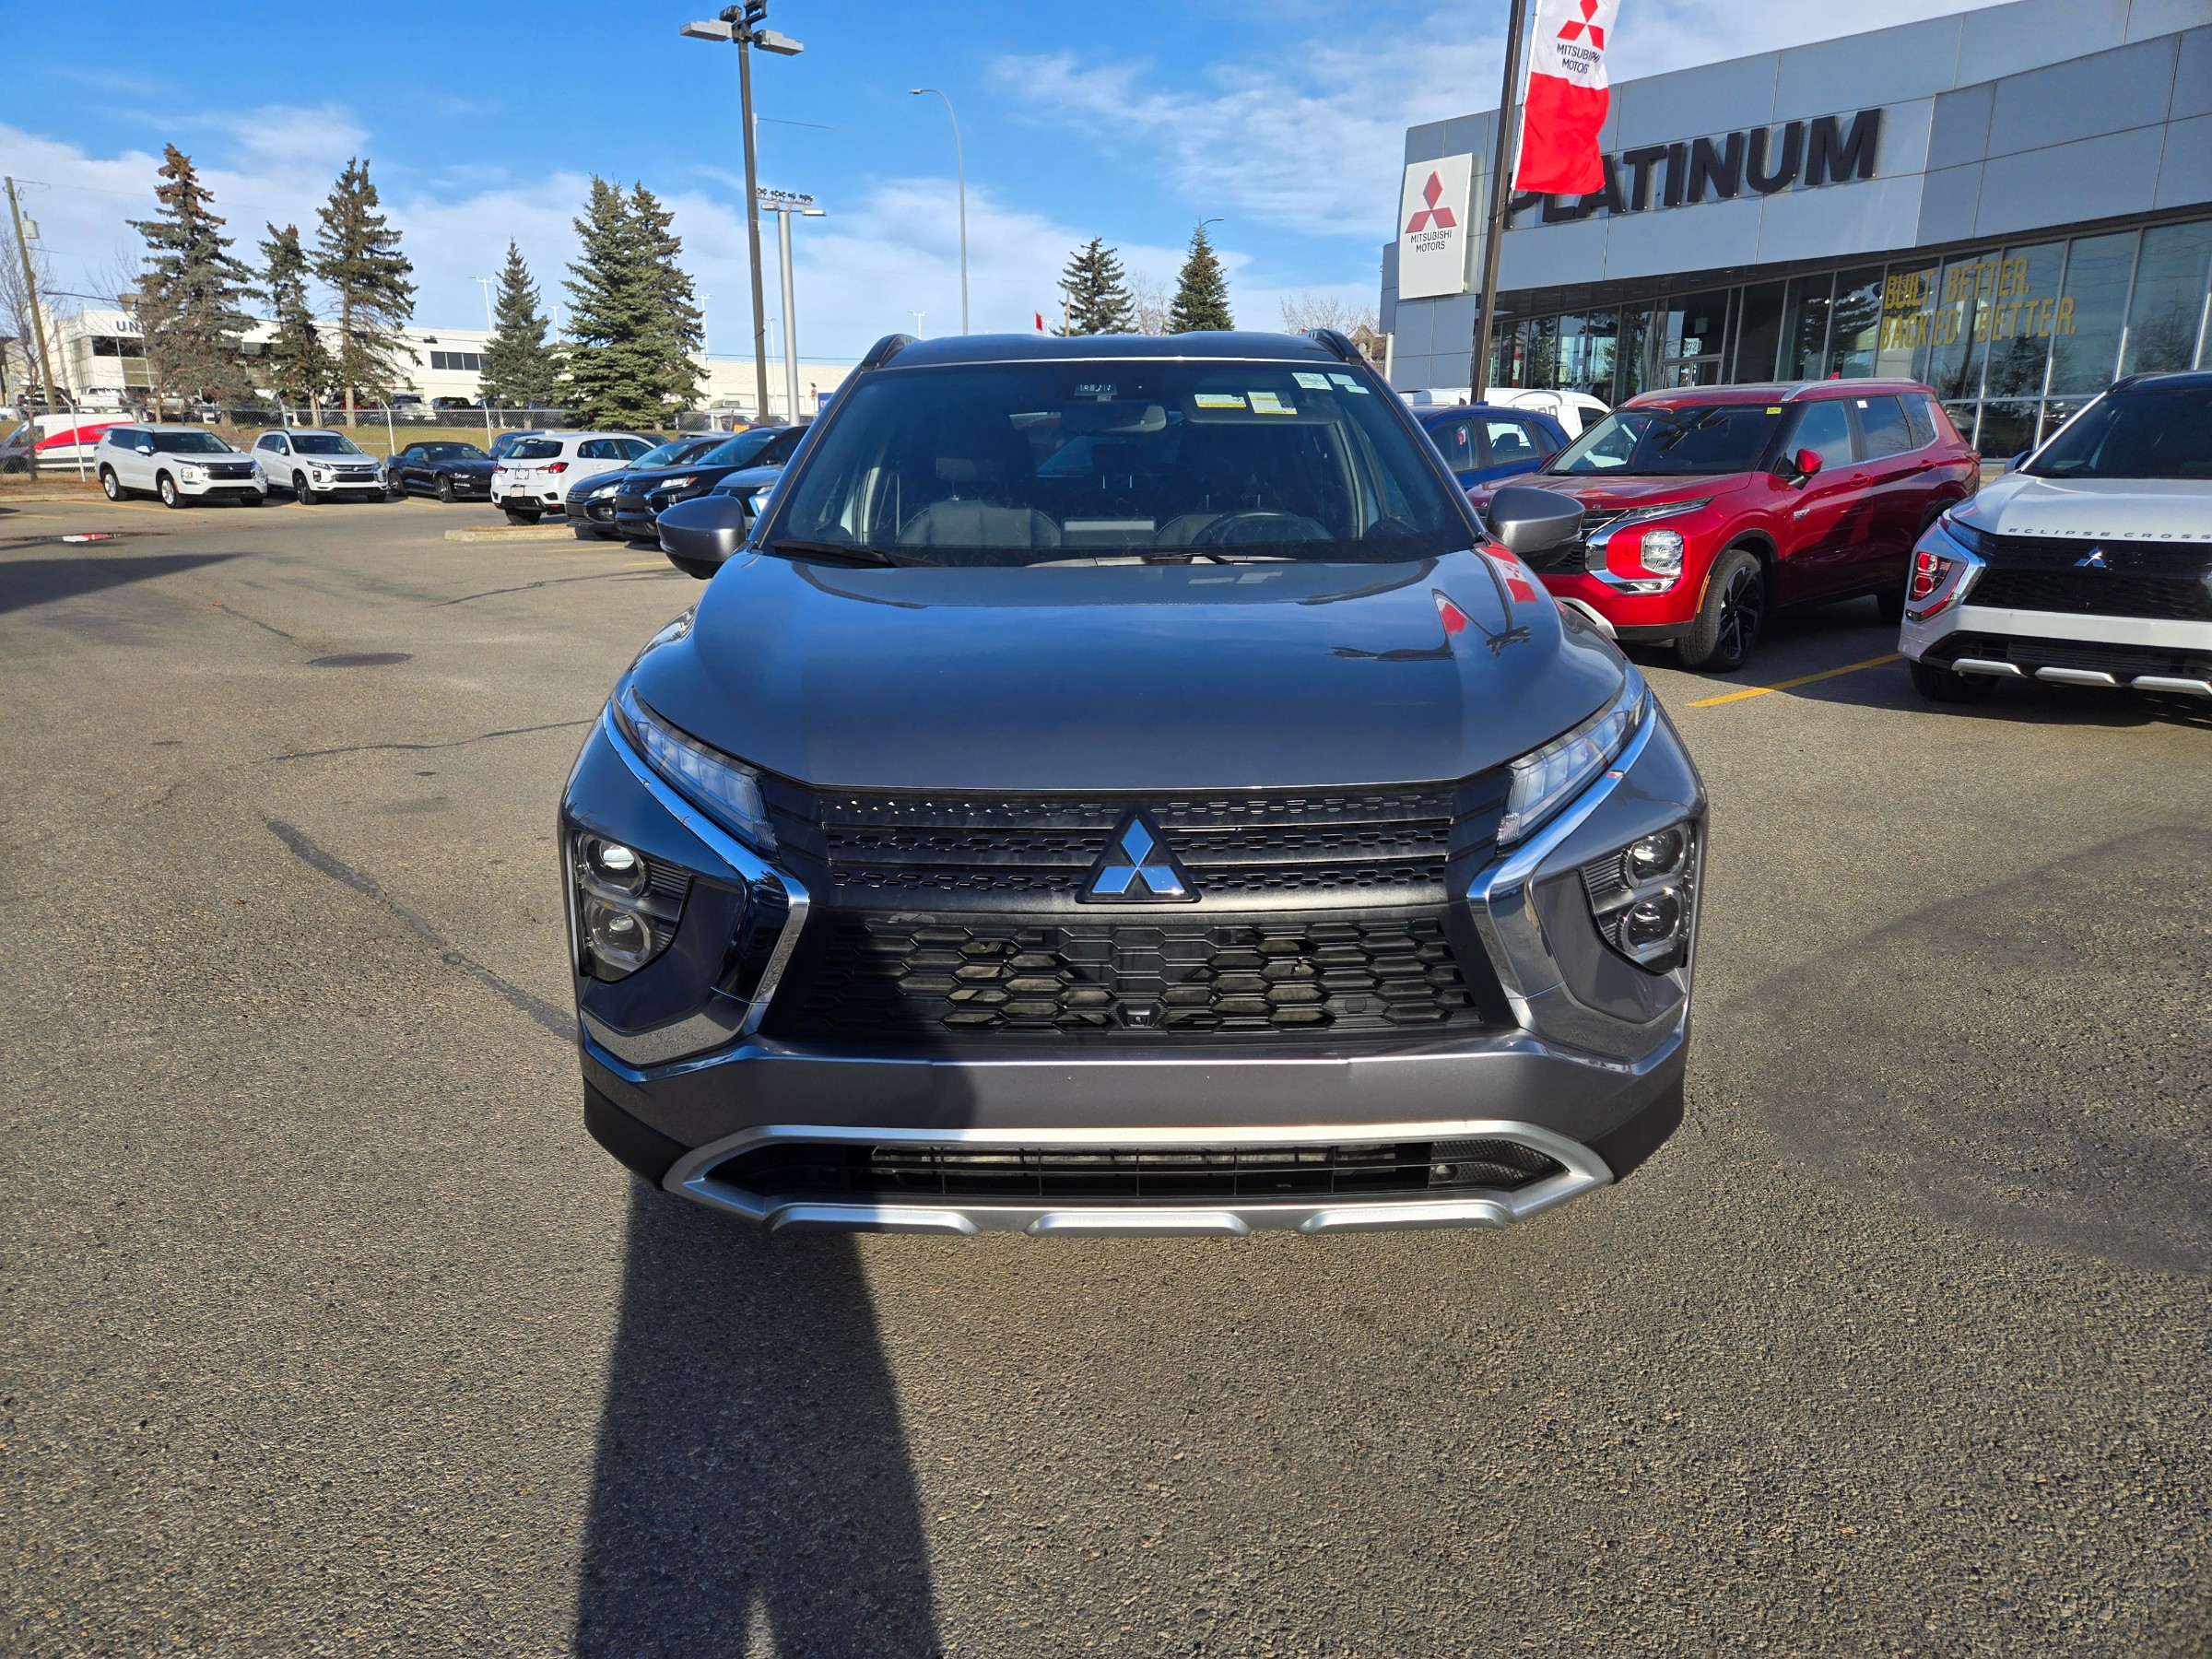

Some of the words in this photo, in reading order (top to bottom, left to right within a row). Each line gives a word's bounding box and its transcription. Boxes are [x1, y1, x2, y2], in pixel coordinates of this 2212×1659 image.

[1561, 57, 1590, 75] MOTOS
[1410, 229, 1452, 244] MITSUBISHI
[1416, 241, 1445, 253] MOTORS
[1883, 269, 1935, 311] BUILT
[1946, 257, 2031, 302] BETTER.
[1878, 309, 1959, 350] BACKED
[1975, 297, 2077, 344] BETTER.
[2007, 527, 2112, 537] ECLIPSE
[2123, 532, 2212, 540] CROSS
